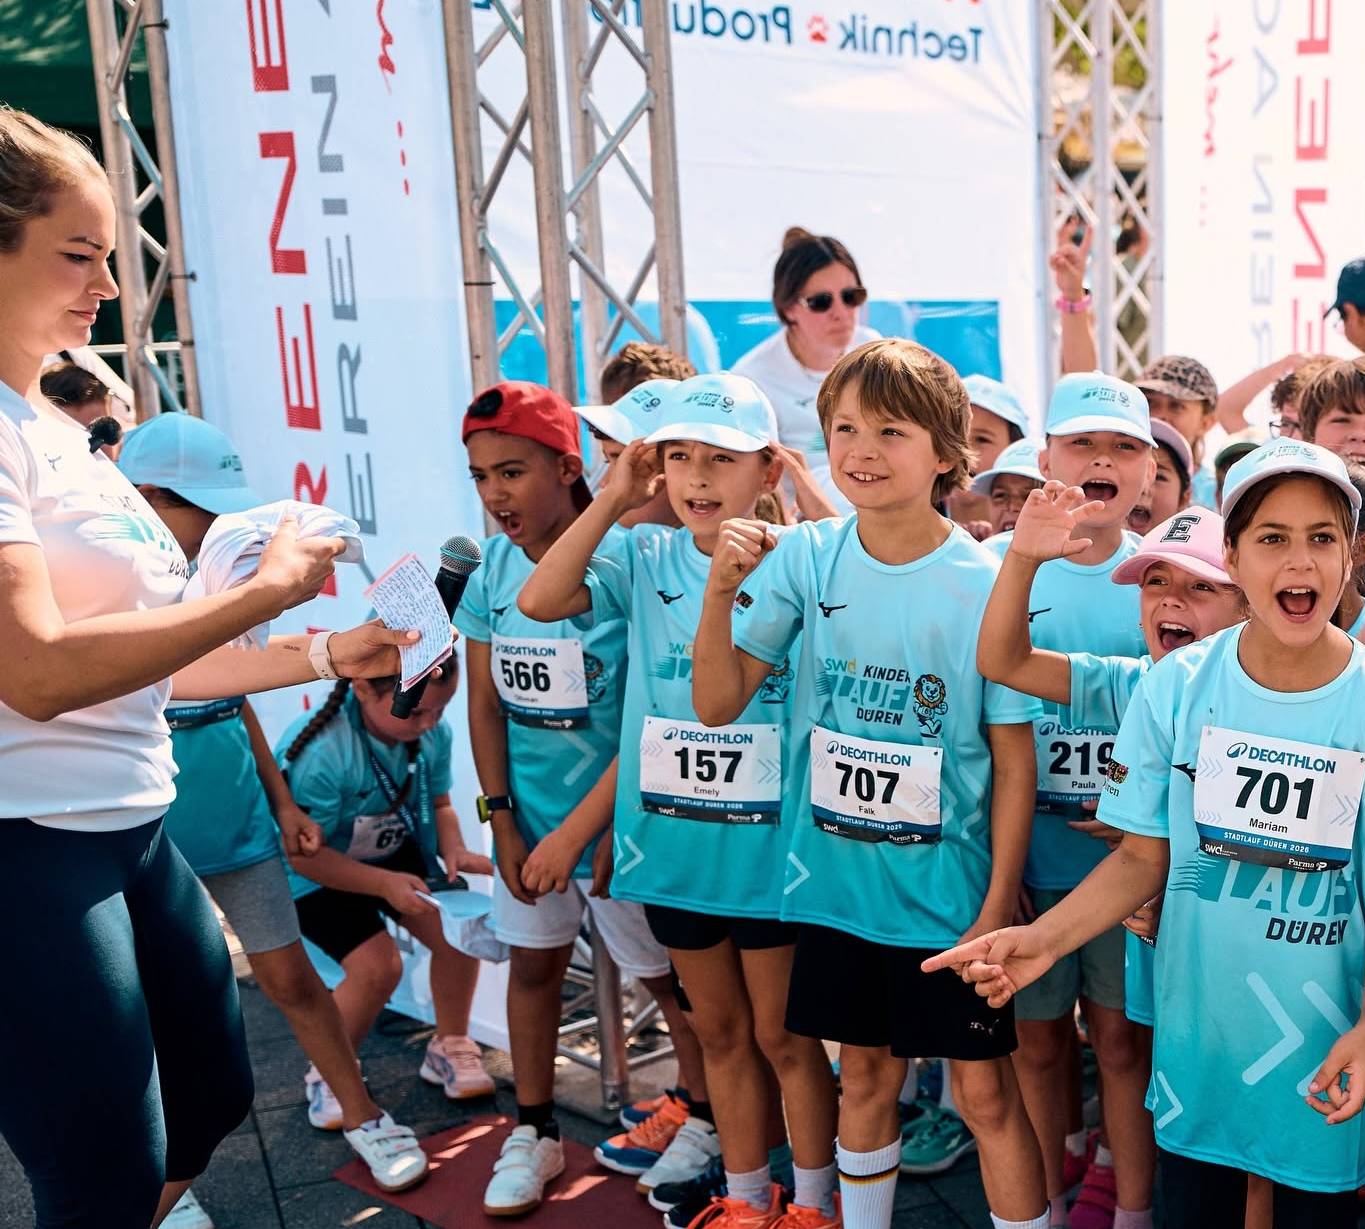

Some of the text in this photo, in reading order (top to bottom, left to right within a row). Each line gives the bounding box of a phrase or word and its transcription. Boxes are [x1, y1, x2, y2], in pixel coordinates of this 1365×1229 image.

[1160, 515, 1201, 542] E
[500, 658, 551, 692] 566
[856, 707, 904, 726] DÜREN
[680, 730, 753, 744] DECATHLON
[674, 746, 743, 783] 157
[840, 745, 911, 766] DECATHLON
[1048, 741, 1115, 776] 219
[1248, 747, 1336, 774] DECATHLON
[694, 786, 720, 797] Emely
[835, 761, 900, 804] 707
[1071, 780, 1096, 789] Paula
[1235, 766, 1315, 820] 701
[858, 805, 876, 816] Falk
[1249, 817, 1288, 834] Mariam
[1224, 831, 1310, 853] STADTLAUF DÜREN 2026
[1288, 857, 1315, 868] Parma
